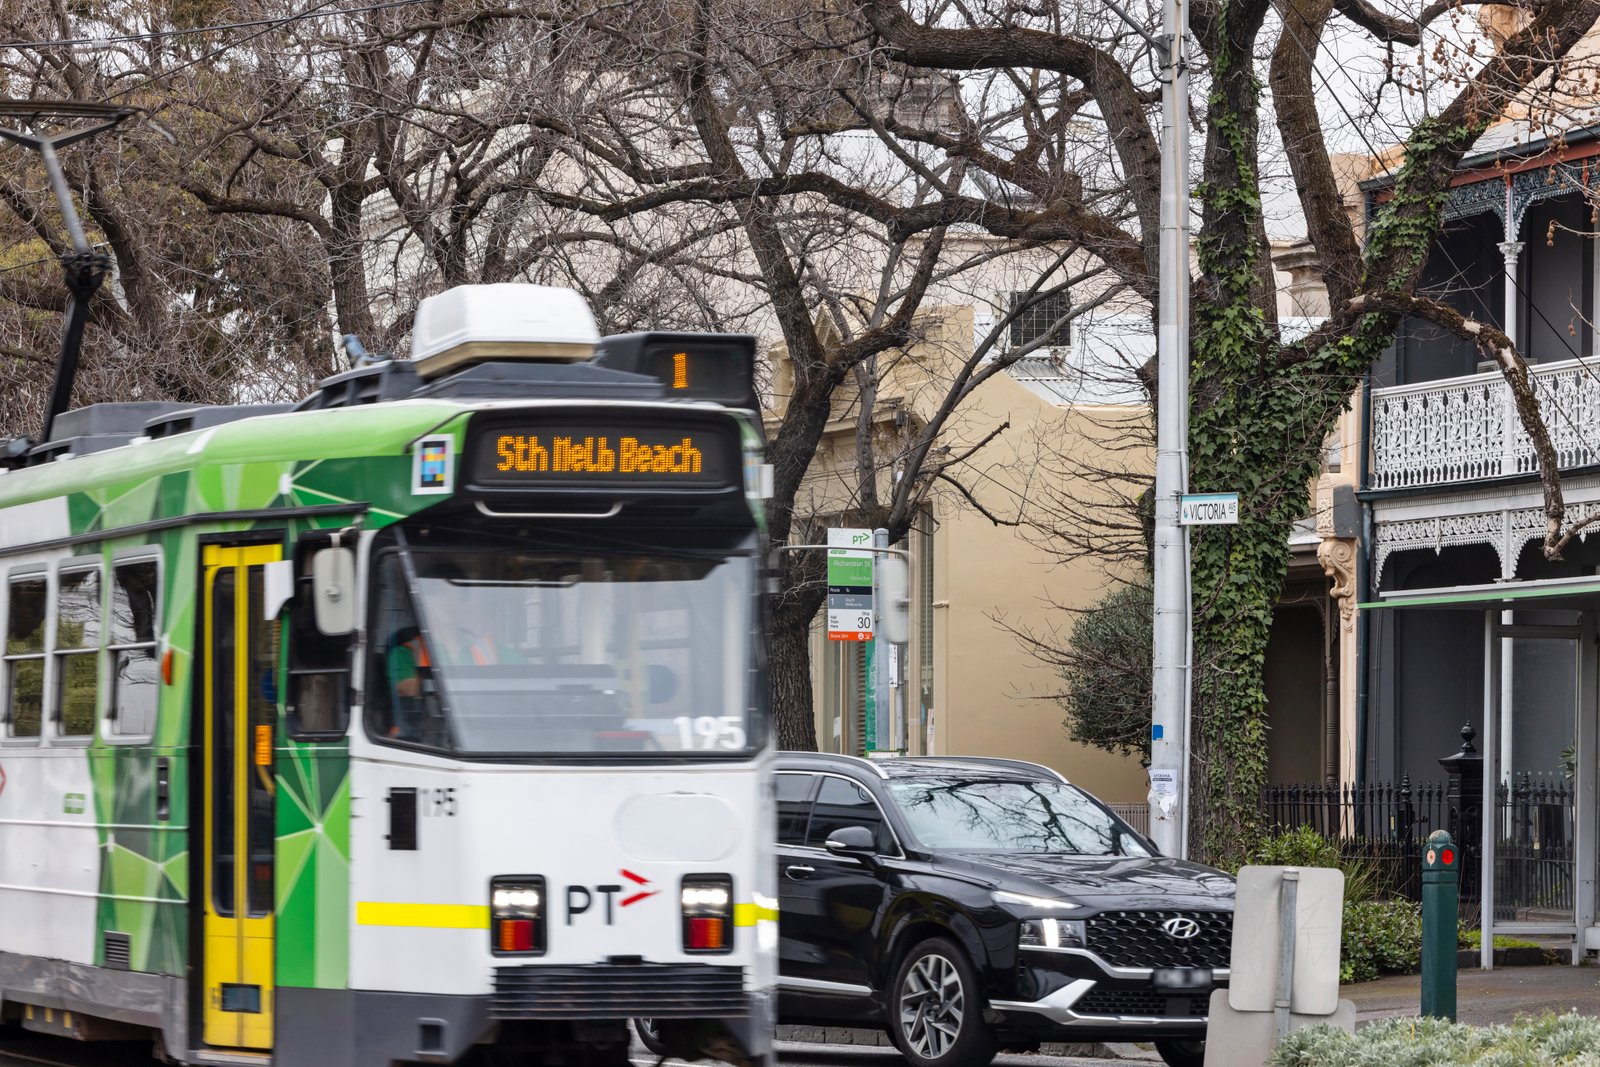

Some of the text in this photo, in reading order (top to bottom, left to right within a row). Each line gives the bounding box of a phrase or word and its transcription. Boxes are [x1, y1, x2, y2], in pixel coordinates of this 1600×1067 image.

[672, 352, 689, 389] 1
[497, 435, 702, 474] Sth Melb Beach
[1189, 502, 1227, 521] VICTORIA
[857, 616, 871, 629] 30
[673, 716, 747, 750] 195
[565, 884, 622, 926] PT
